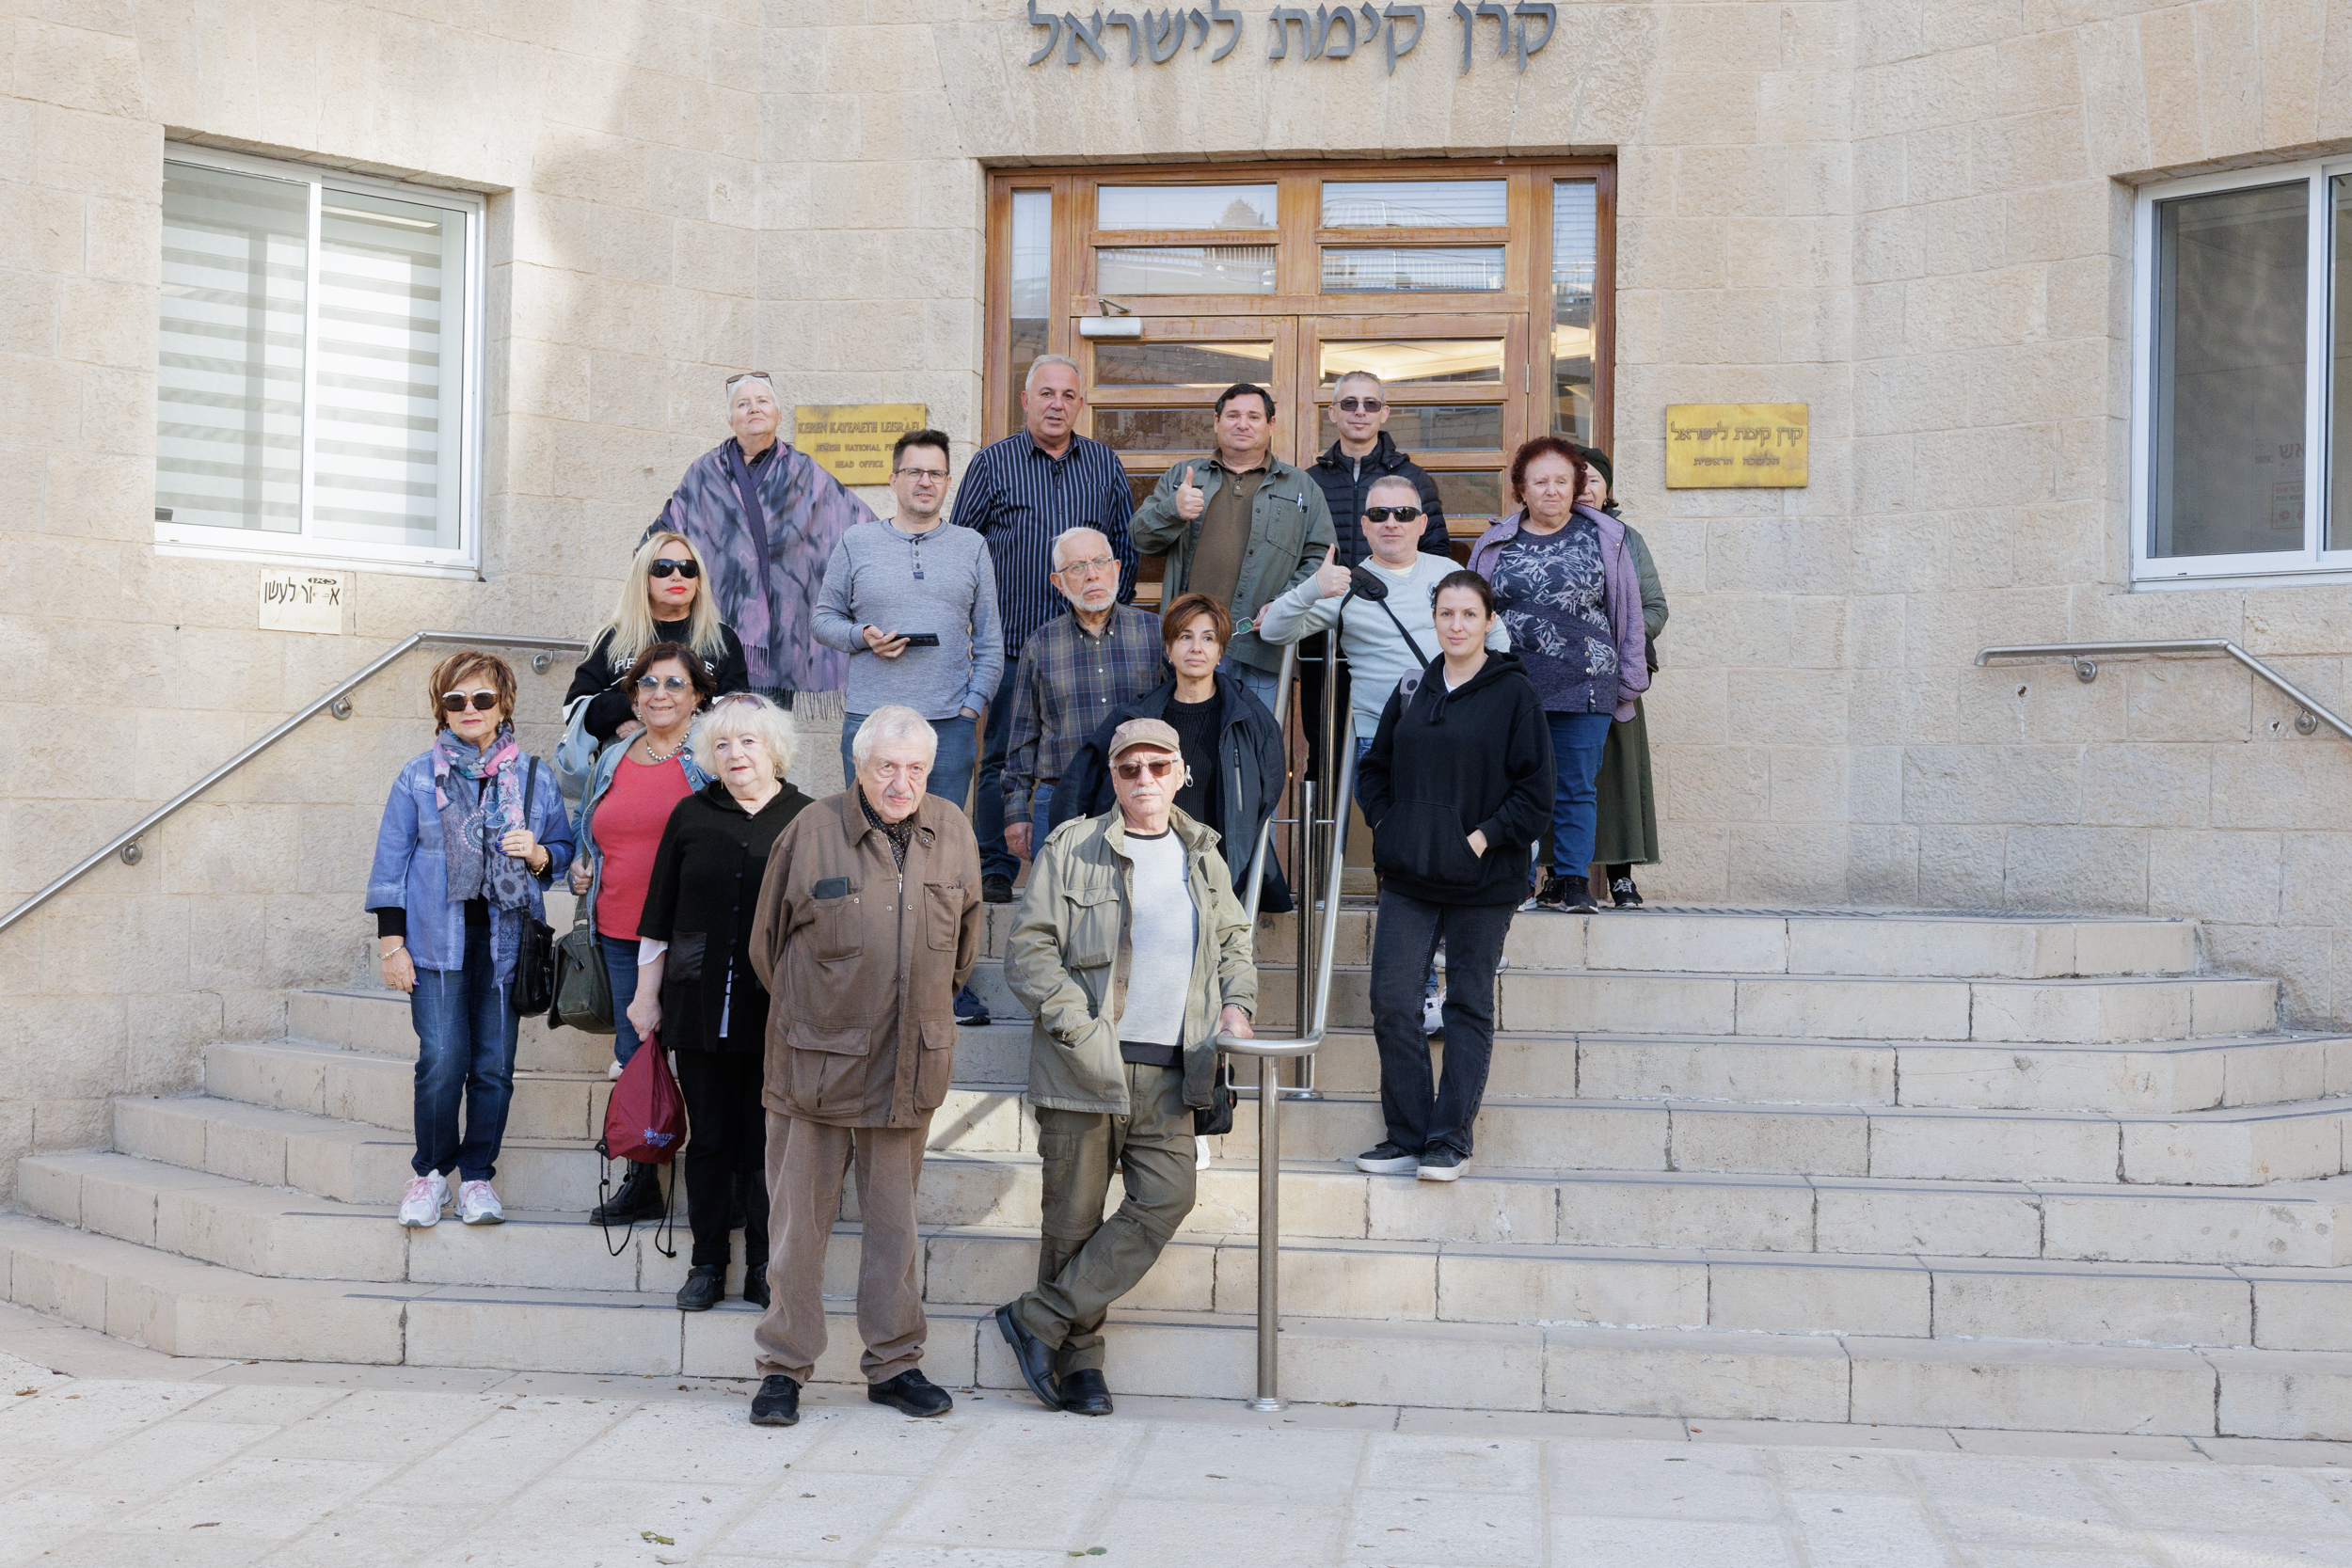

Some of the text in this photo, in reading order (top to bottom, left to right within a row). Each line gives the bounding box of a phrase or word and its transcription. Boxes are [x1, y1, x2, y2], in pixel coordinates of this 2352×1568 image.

[1028, 0, 1558, 76] קרן קימת לישראל
[798, 421, 827, 434] KEREN
[829, 420, 878, 434] KAYEMETH
[1670, 420, 1804, 447] קרן קימת לישראל
[814, 443, 895, 452] JEWISH NATIONAL FU
[834, 460, 884, 468] HEAD OFFICE
[1692, 451, 1780, 467] הלשכה הראשית
[264, 577, 296, 605] לעשן
